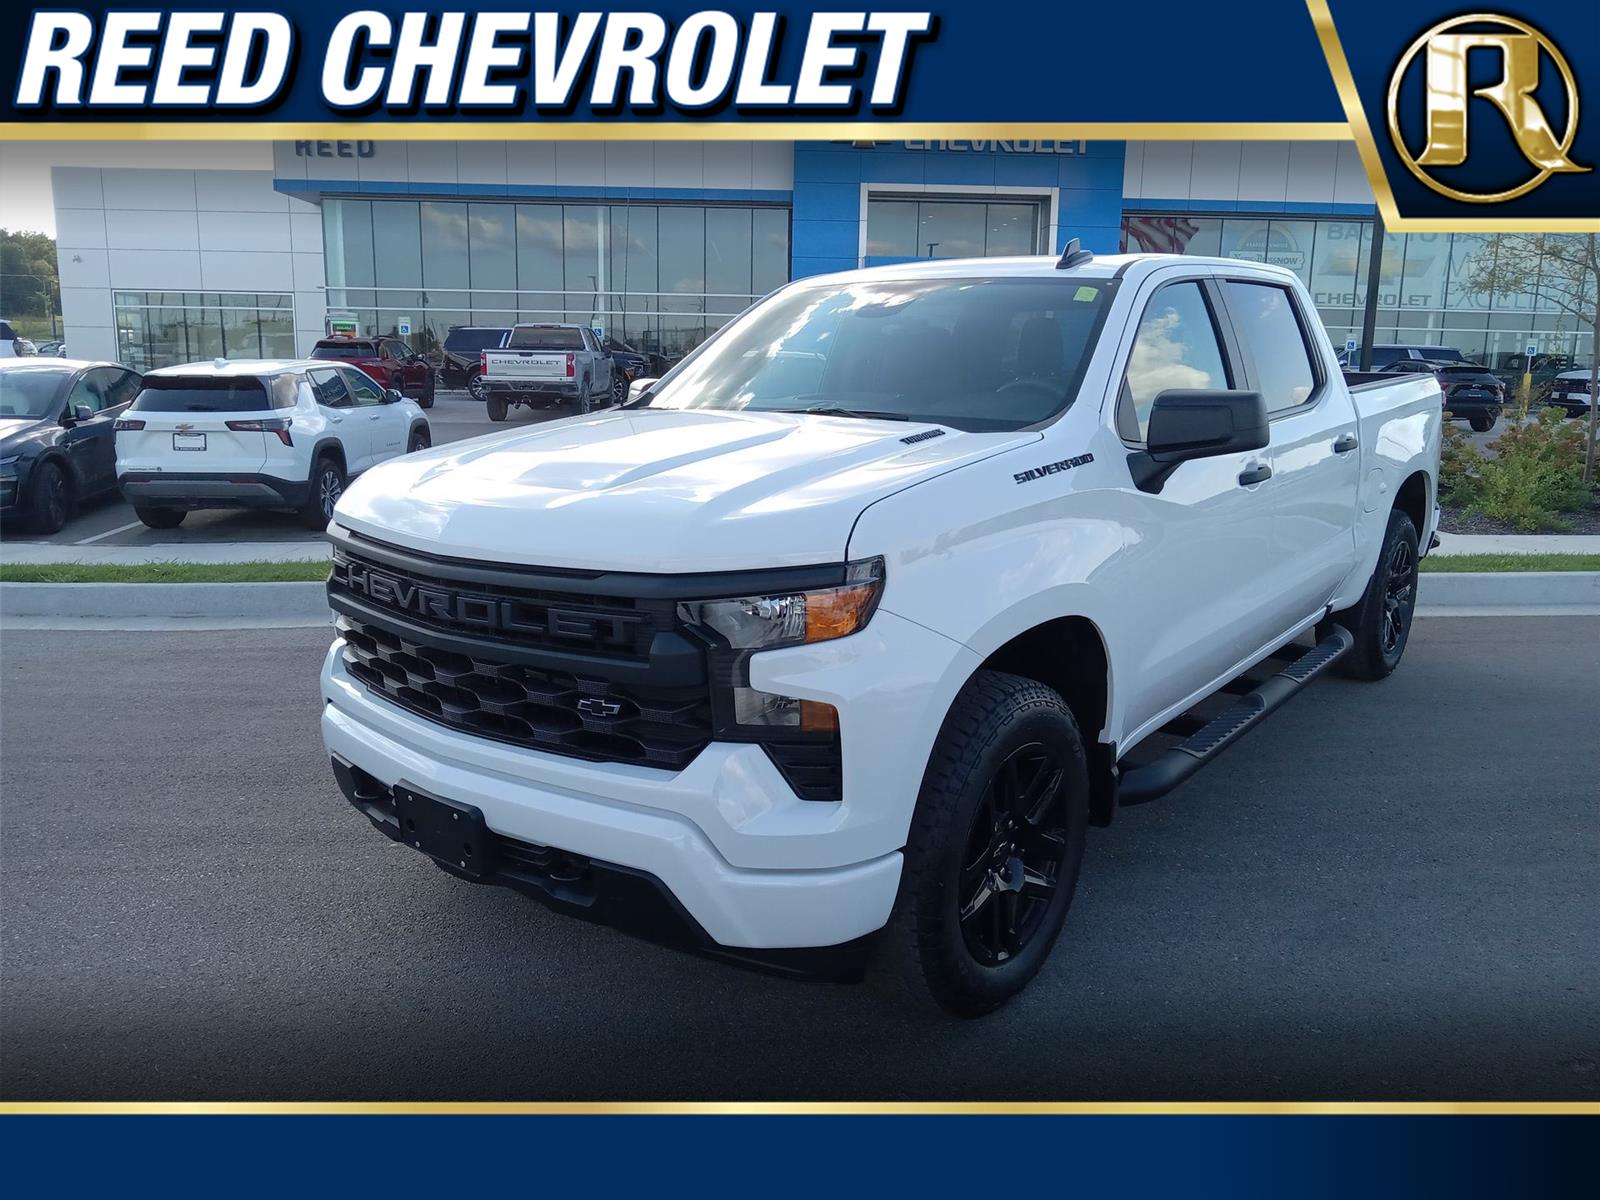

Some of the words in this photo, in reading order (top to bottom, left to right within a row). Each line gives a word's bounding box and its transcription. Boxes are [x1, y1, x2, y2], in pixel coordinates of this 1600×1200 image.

[490, 358, 562, 366] CHEVROLET
[1013, 452, 1095, 485] SILVERADO
[333, 556, 648, 643] CHEVROLET
